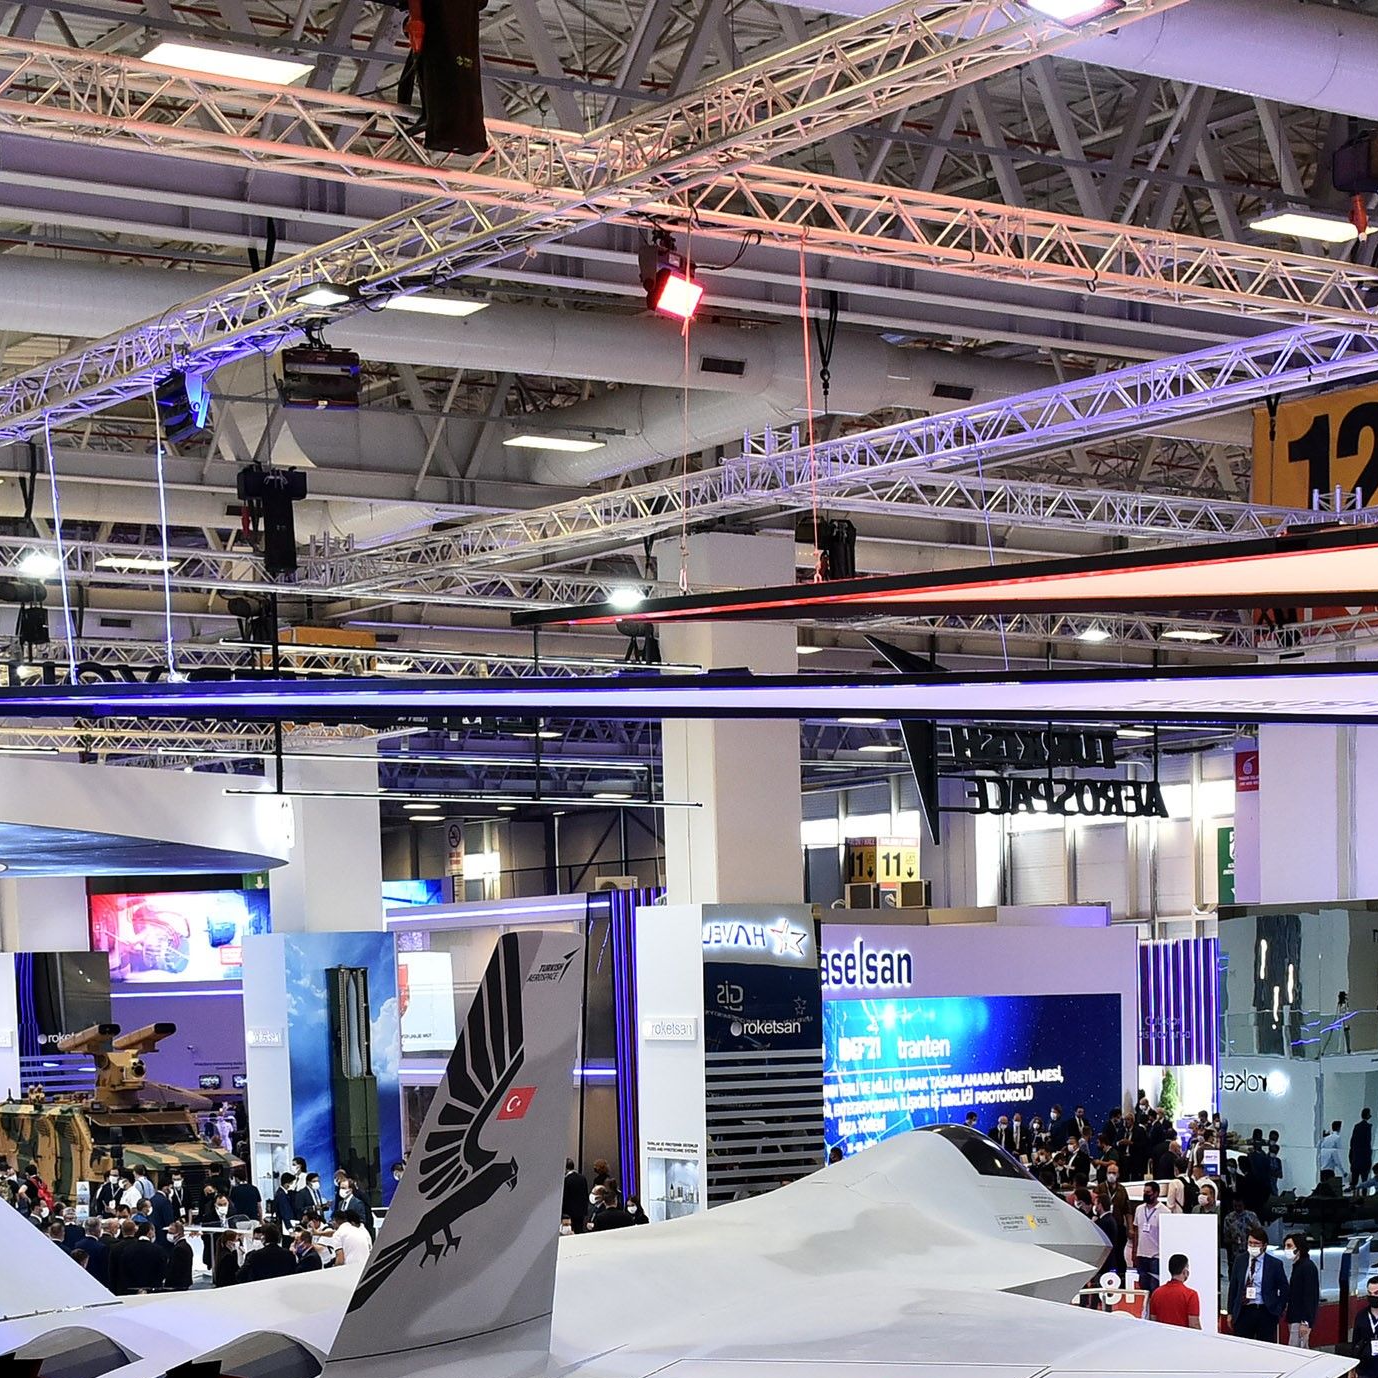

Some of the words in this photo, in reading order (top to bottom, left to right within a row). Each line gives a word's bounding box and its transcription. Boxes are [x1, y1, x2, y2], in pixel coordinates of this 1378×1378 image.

[882, 852, 901, 877] 11
[651, 1021, 693, 1037] roketsan
[743, 1021, 802, 1035] roketsan
